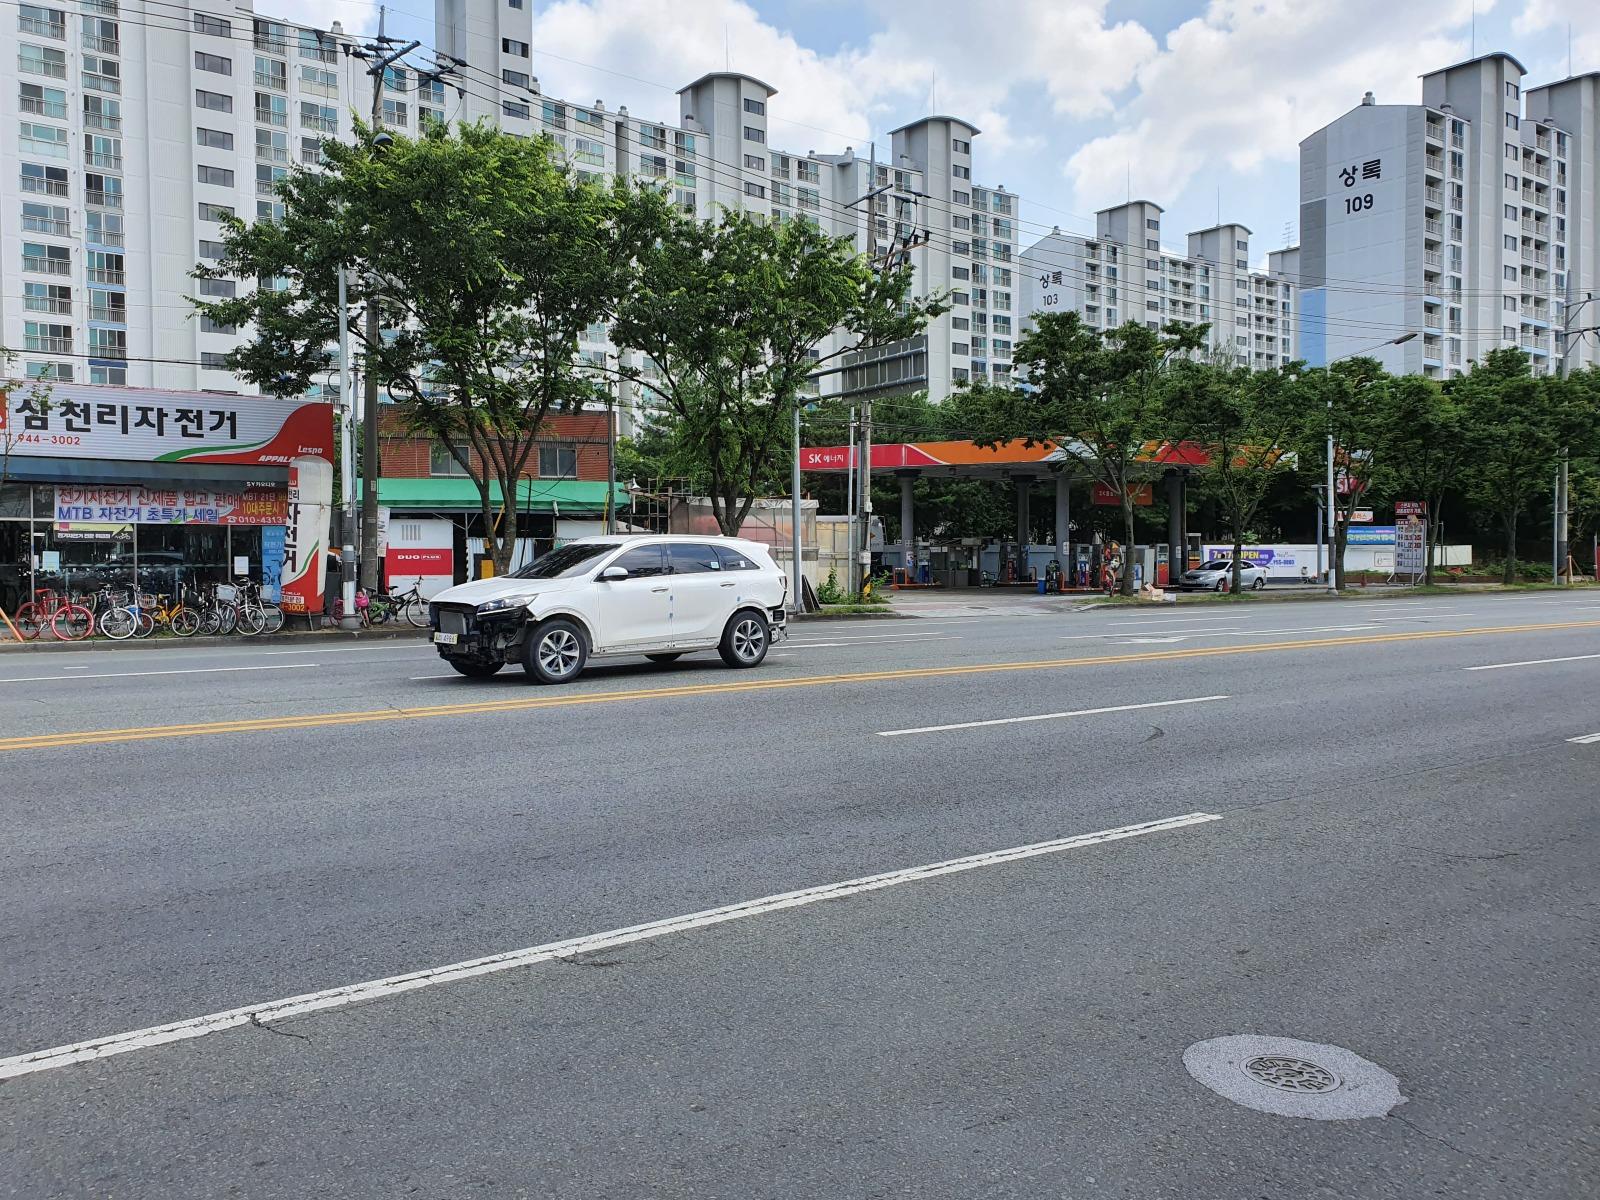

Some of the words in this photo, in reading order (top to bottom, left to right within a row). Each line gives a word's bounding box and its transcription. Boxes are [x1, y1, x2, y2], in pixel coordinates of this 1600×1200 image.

[1339, 159, 1381, 187] 상록
[1345, 194, 1373, 214] 109
[1040, 271, 1062, 289] 상록
[1043, 294, 1058, 306] 103
[16, 399, 237, 439] 삼천리자전거
[18, 434, 80, 445] 944-3002
[298, 445, 323, 454] Lespo
[808, 454, 822, 463] SK
[823, 454, 844, 463] 에너지
[59, 487, 132, 505] 전기자전거
[183, 489, 209, 507] 입고
[58, 506, 93, 520] MTB
[99, 506, 141, 521] 자전거
[147, 507, 188, 522] 초특가
[193, 508, 219, 523] 세일
